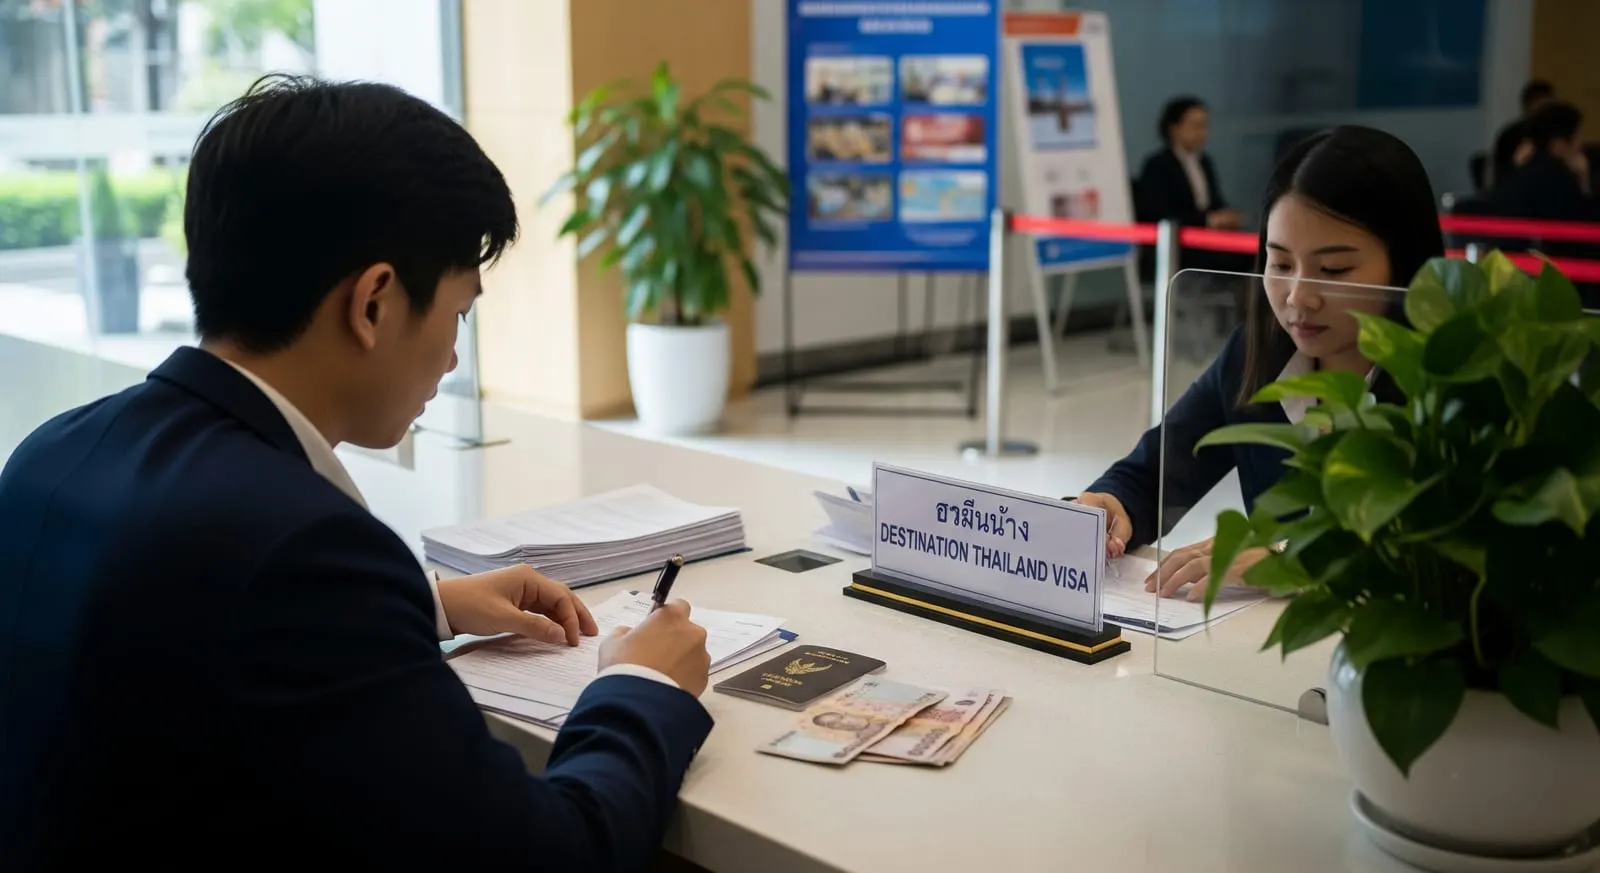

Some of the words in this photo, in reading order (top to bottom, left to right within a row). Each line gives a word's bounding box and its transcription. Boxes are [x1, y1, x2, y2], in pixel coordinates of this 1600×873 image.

[880, 522, 969, 563] DESTINATION
[971, 543, 1048, 582] THAILAND
[1052, 563, 1089, 594] VISA
